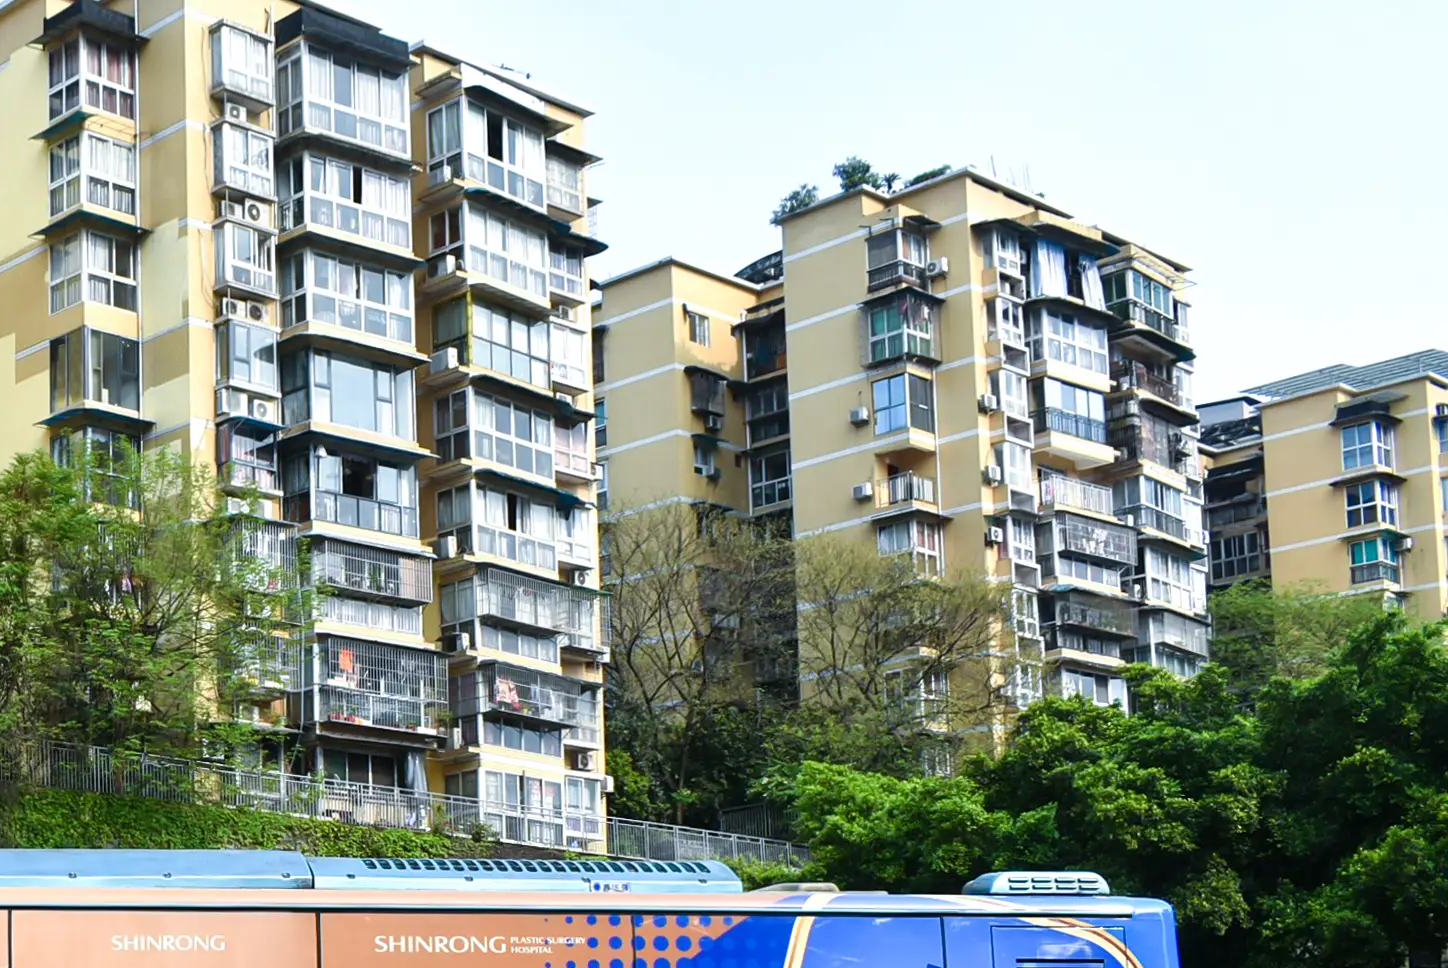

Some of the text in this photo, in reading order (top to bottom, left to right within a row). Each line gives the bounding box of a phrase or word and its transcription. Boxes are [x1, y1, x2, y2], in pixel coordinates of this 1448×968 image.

[111, 934, 226, 951] SHINRONG
[374, 935, 506, 953] SHINRONG
[510, 936, 586, 945] PLASTIC SURGERY
[510, 946, 553, 954] HOSPITAL
